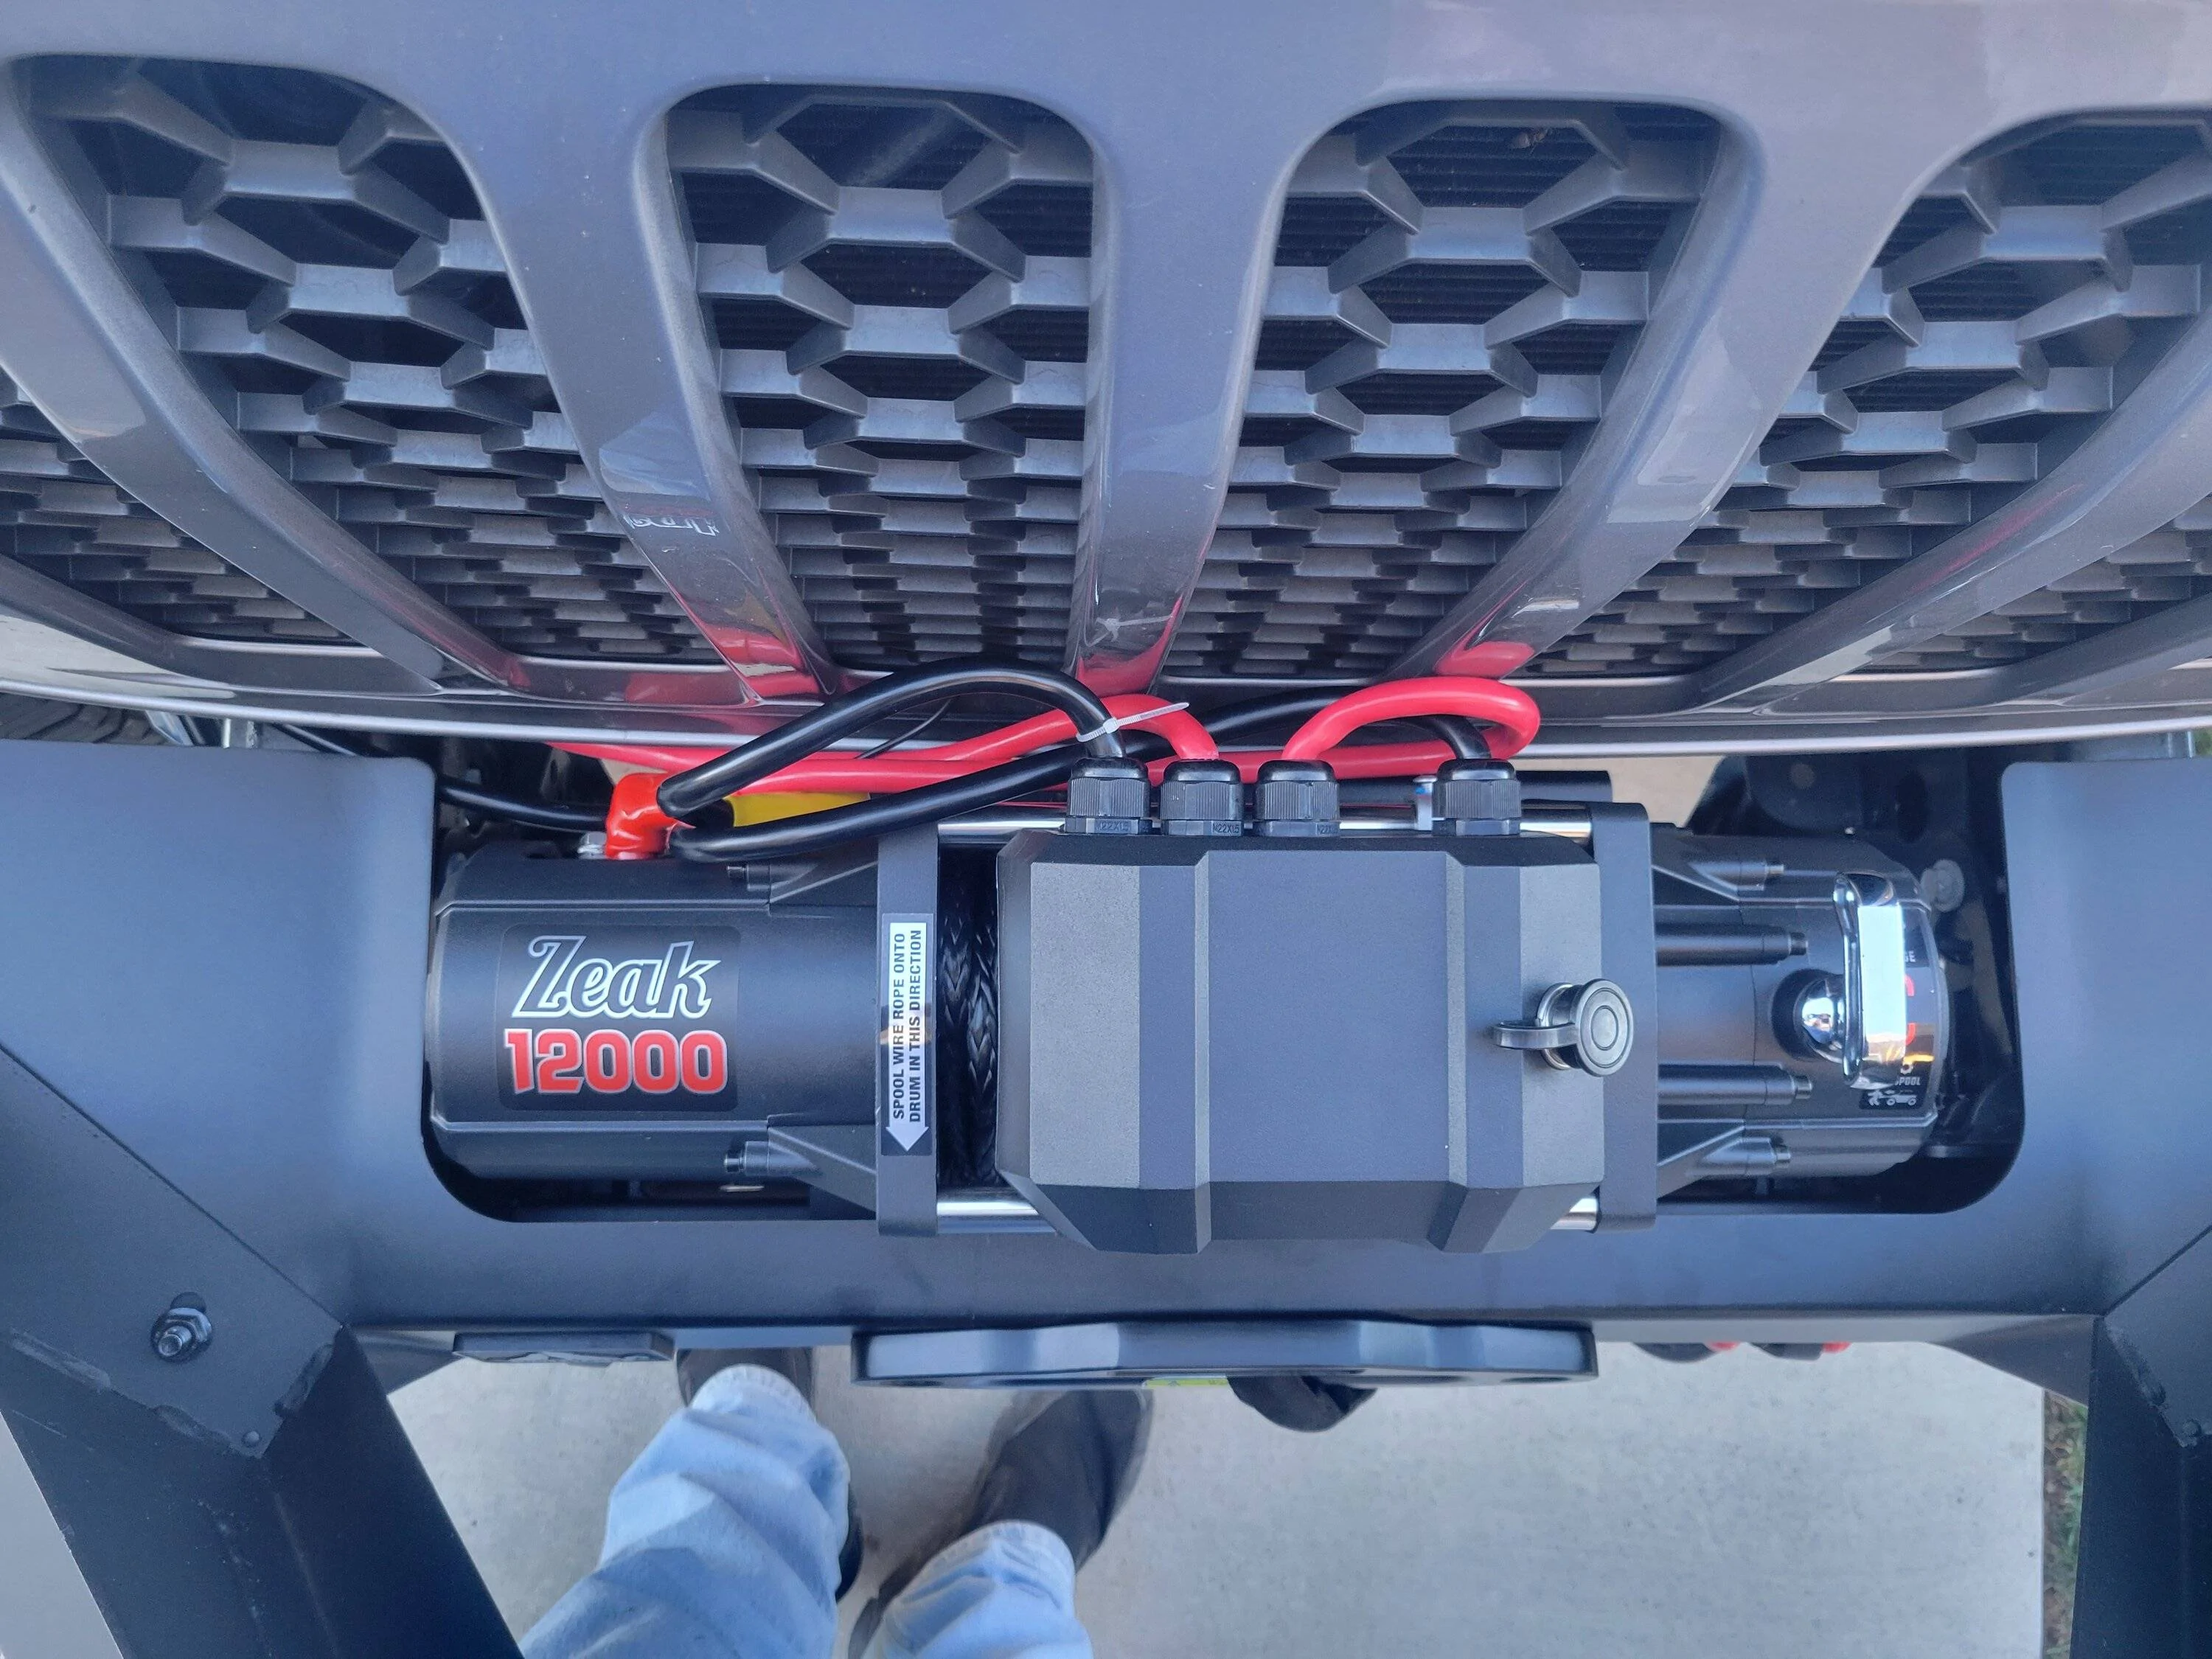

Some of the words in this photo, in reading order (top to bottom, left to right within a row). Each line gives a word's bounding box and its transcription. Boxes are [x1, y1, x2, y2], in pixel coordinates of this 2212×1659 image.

[894, 933, 905, 973] ONTO
[909, 931, 921, 1010] DIRECTION
[512, 935, 721, 1018] Zeak
[893, 979, 904, 1019] ROPE
[893, 1025, 904, 1065] WIRE
[908, 1016, 920, 1051] THIS
[504, 1029, 728, 1093] 12000
[909, 1056, 920, 1071] IN
[893, 1069, 904, 1119] SPOOL
[909, 1077, 920, 1122] DRUM
